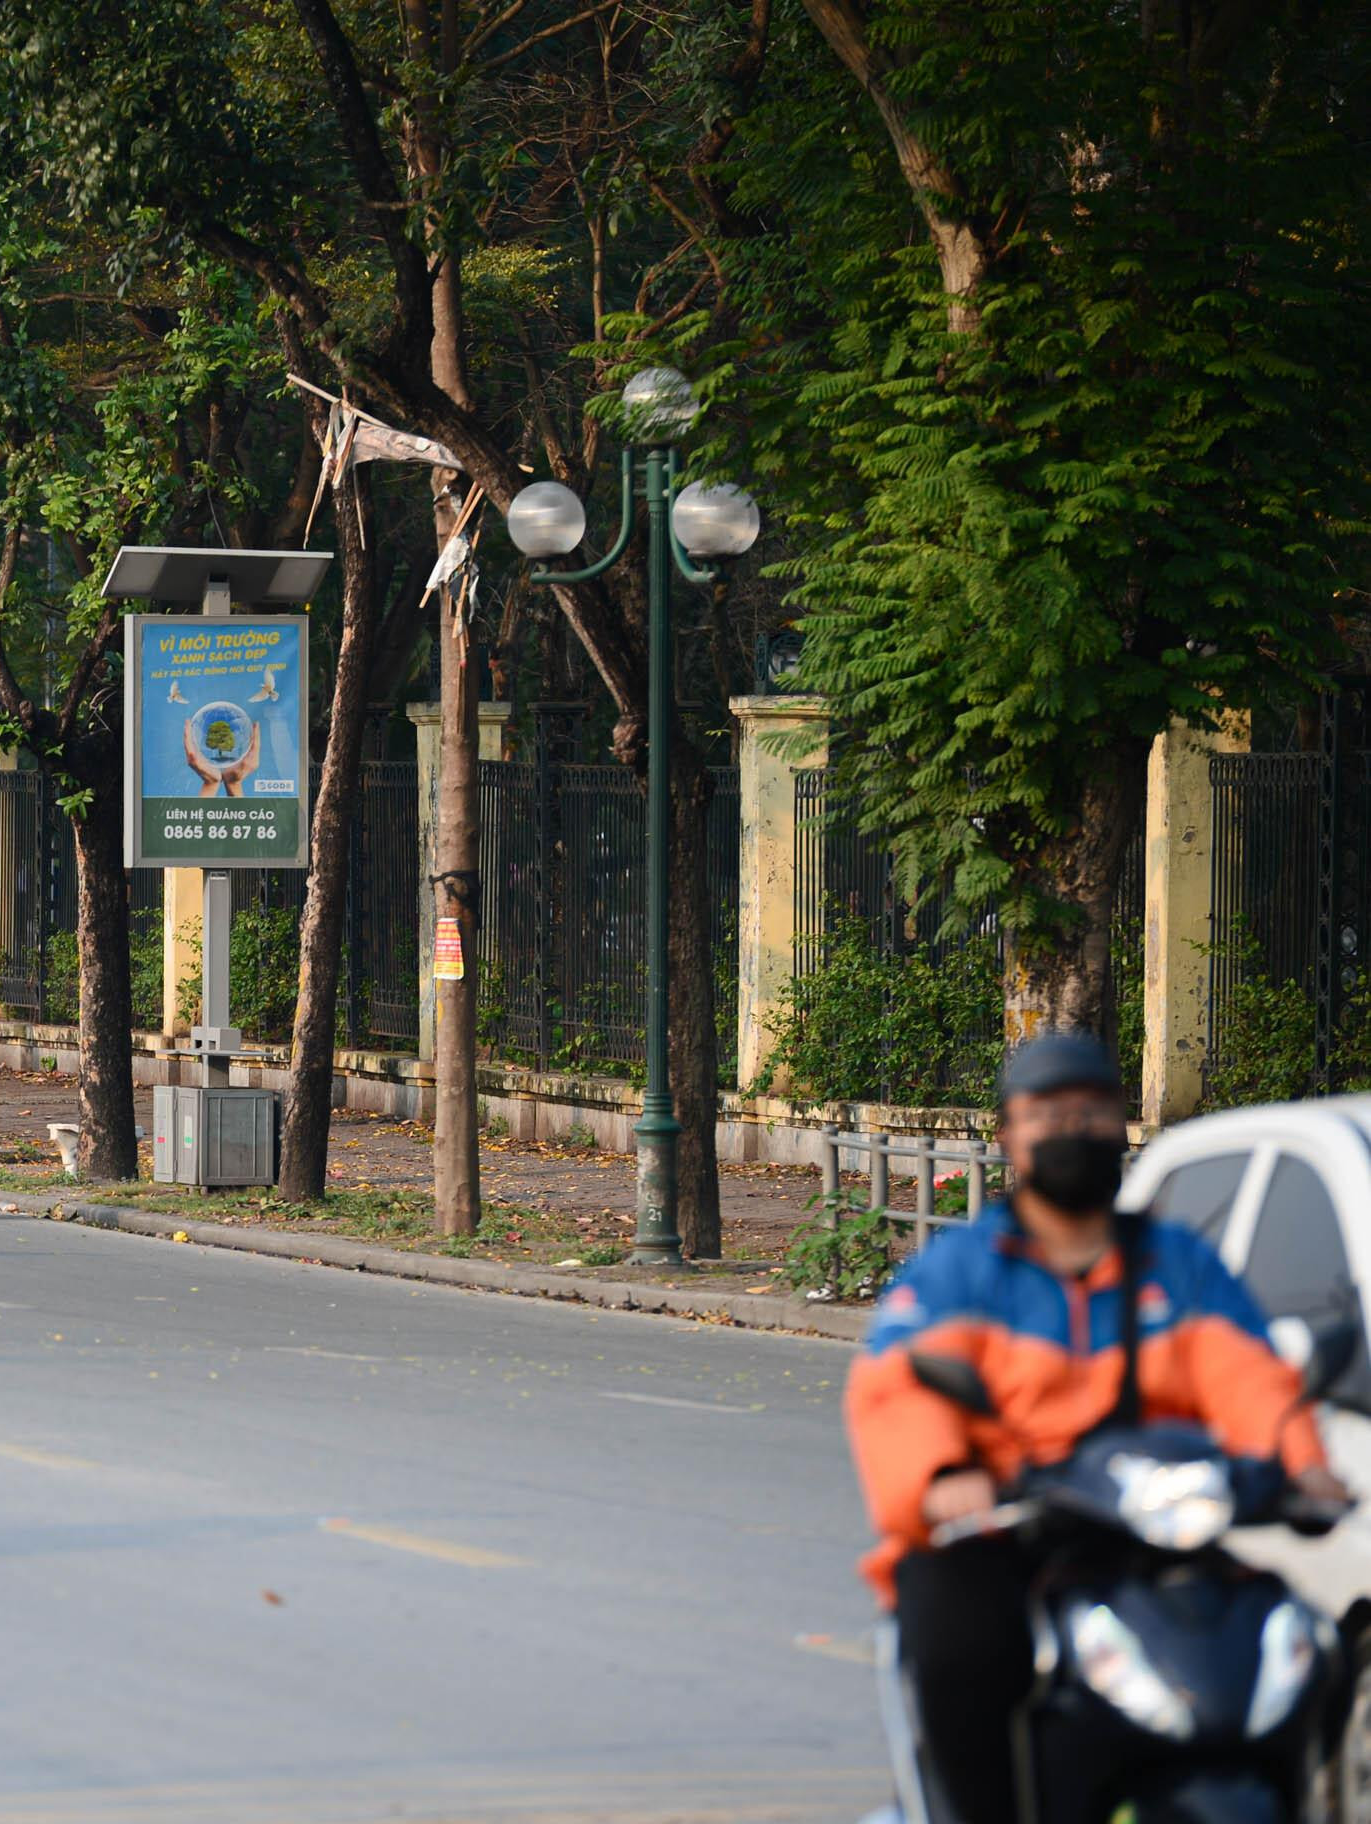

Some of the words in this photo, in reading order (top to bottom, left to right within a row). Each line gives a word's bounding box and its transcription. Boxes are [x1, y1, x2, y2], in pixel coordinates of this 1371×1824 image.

[179, 633, 211, 651] MÔI
[216, 630, 280, 648] TRƯỜNG
[166, 809, 187, 820] LIÊN
[191, 808, 204, 822] HỆ
[207, 808, 246, 820] QUẢNG
[249, 808, 275, 820] CÁO
[164, 825, 203, 839] 0865
[208, 826, 228, 839] 86
[232, 826, 251, 839] 87
[257, 826, 277, 839] 86
